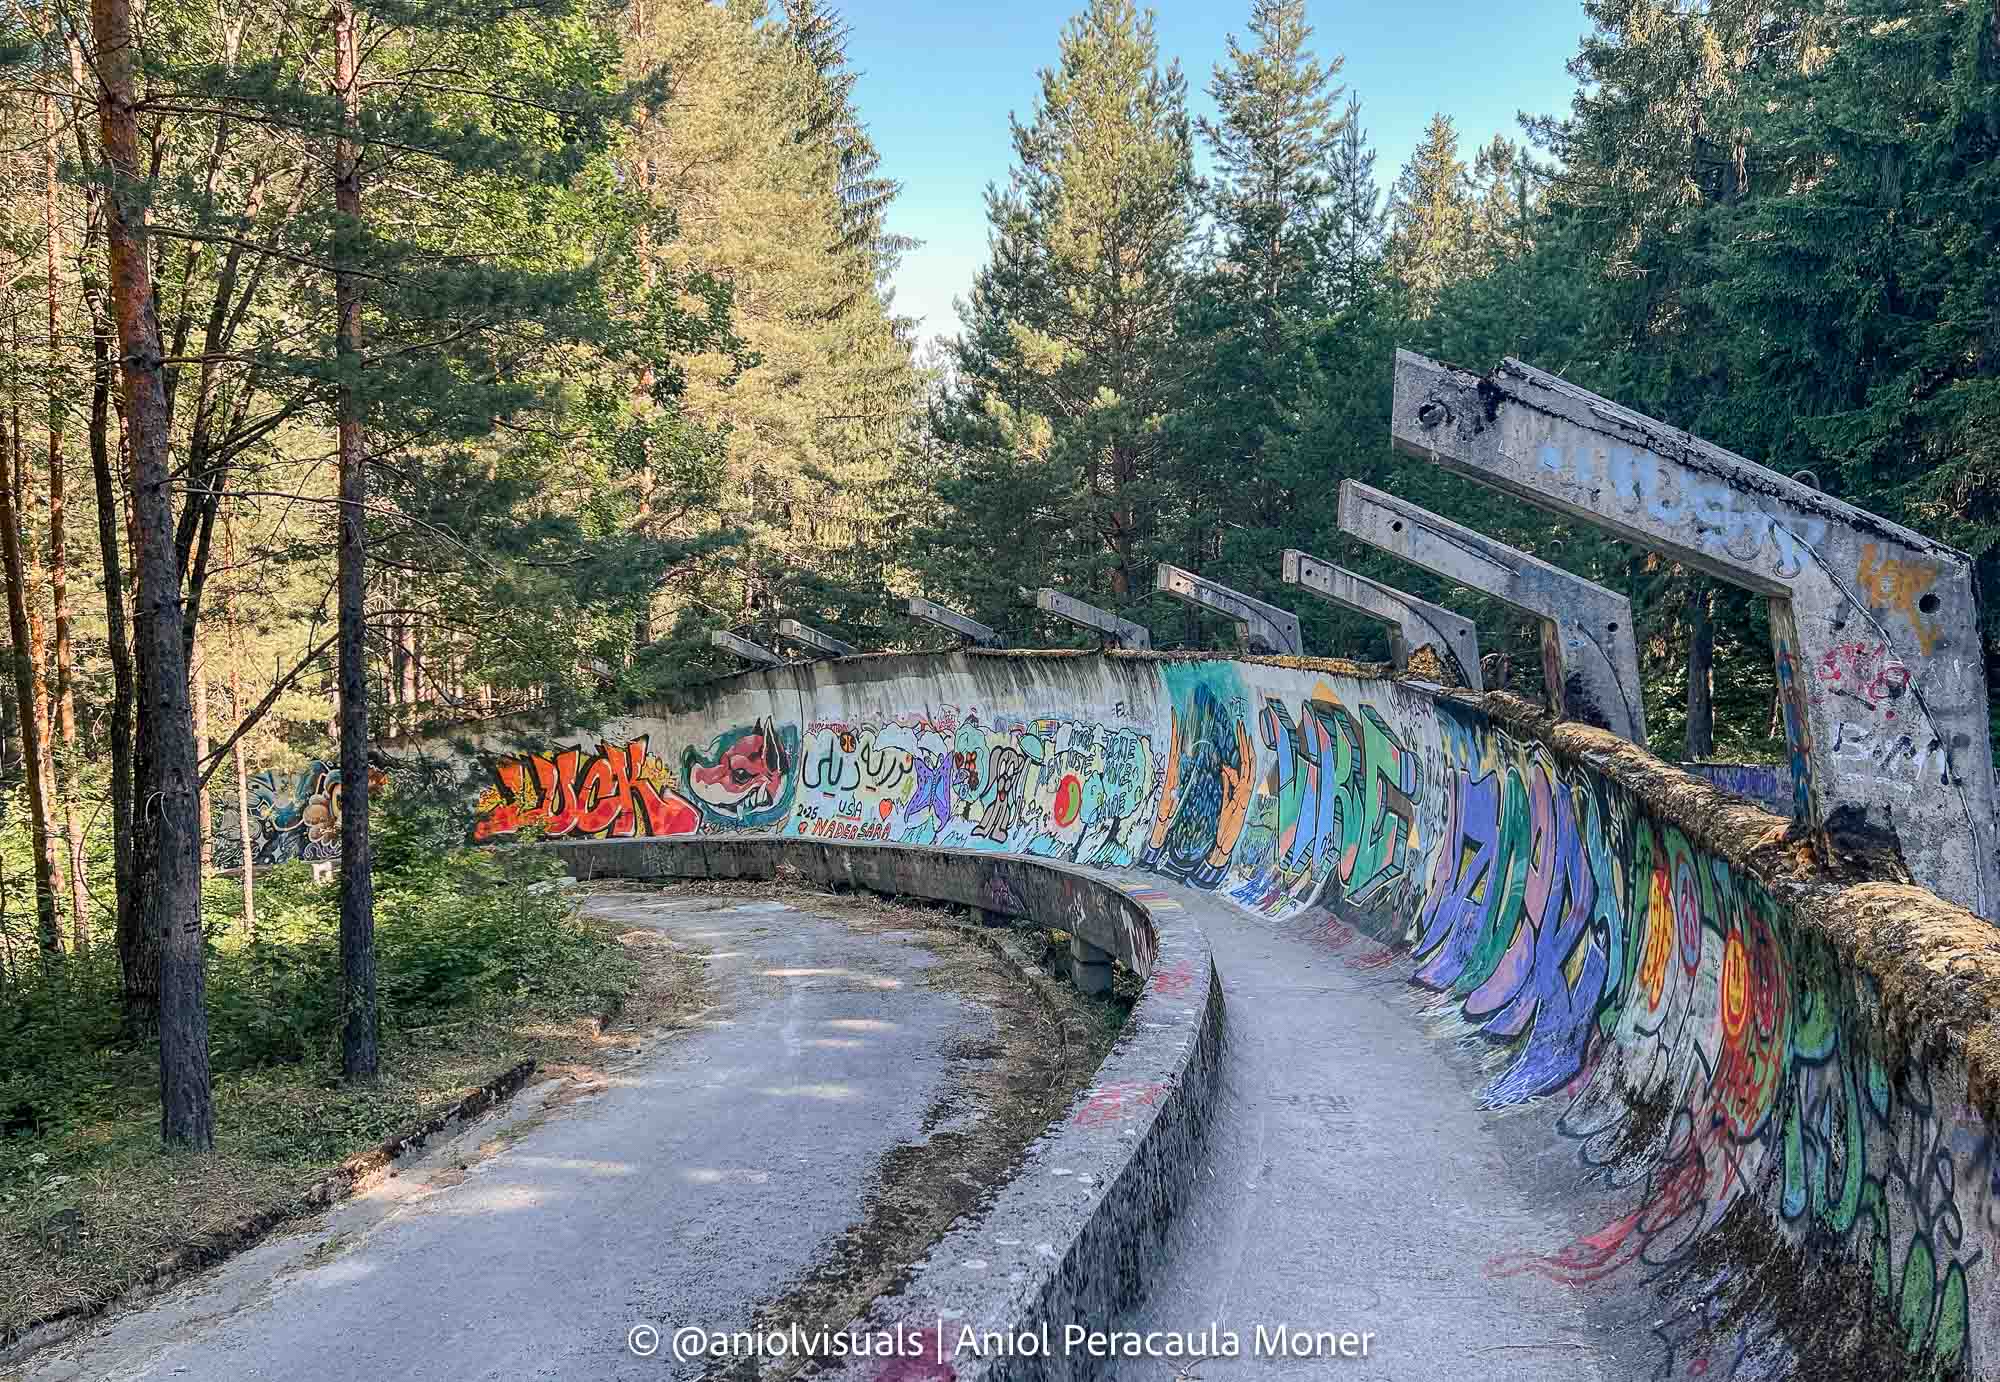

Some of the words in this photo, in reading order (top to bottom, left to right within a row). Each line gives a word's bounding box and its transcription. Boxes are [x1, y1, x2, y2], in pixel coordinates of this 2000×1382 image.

[838, 799, 863, 818] USA
[813, 817, 858, 840] NADER
[859, 822, 891, 841] SARA
